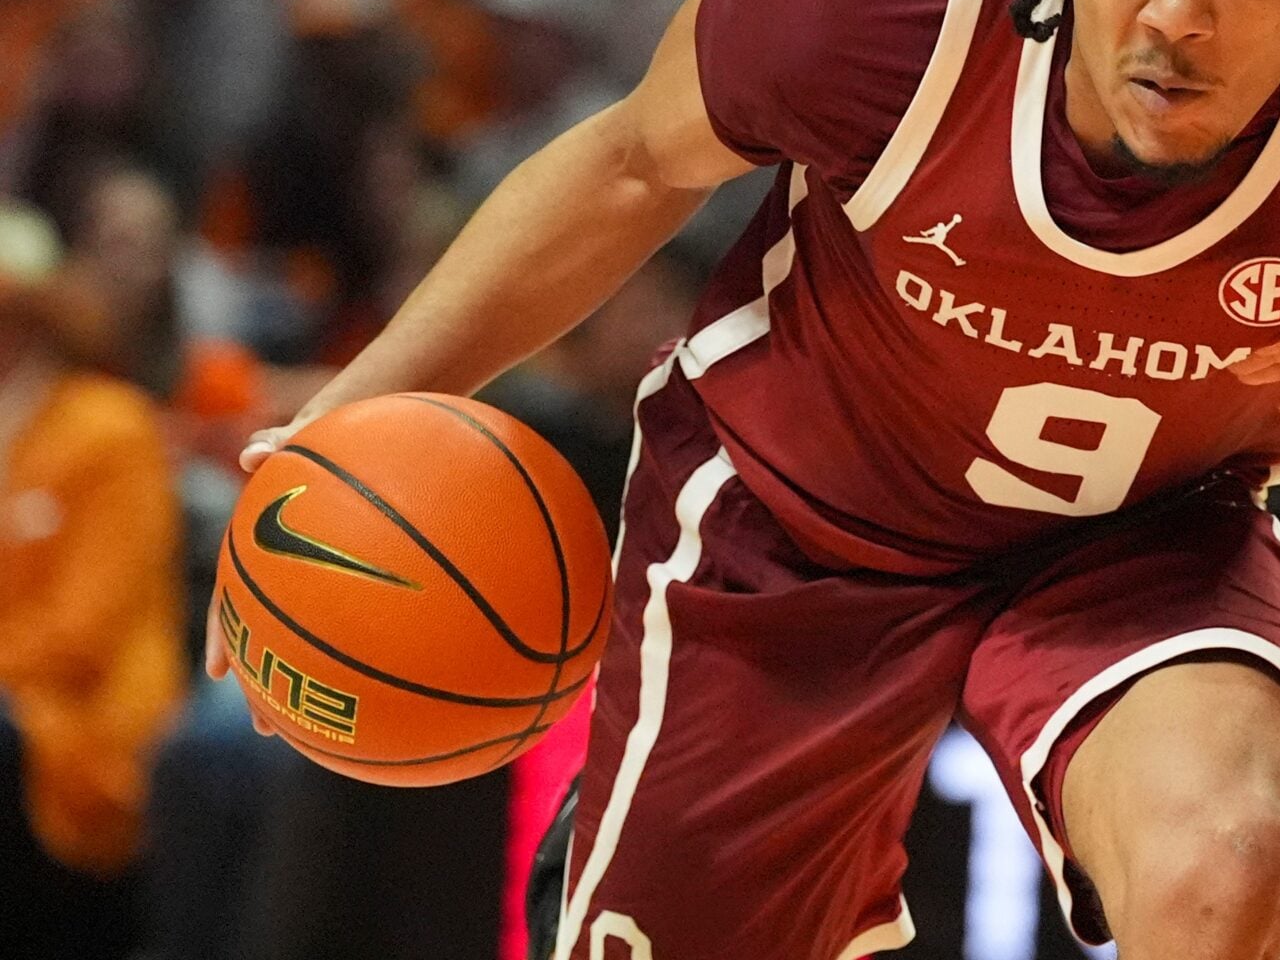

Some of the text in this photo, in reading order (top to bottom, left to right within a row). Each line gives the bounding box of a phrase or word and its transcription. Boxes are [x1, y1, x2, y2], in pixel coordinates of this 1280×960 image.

[895, 269, 1252, 381] OKLAHOM
[964, 381, 1163, 517] 9
[219, 586, 359, 736] ELITE
